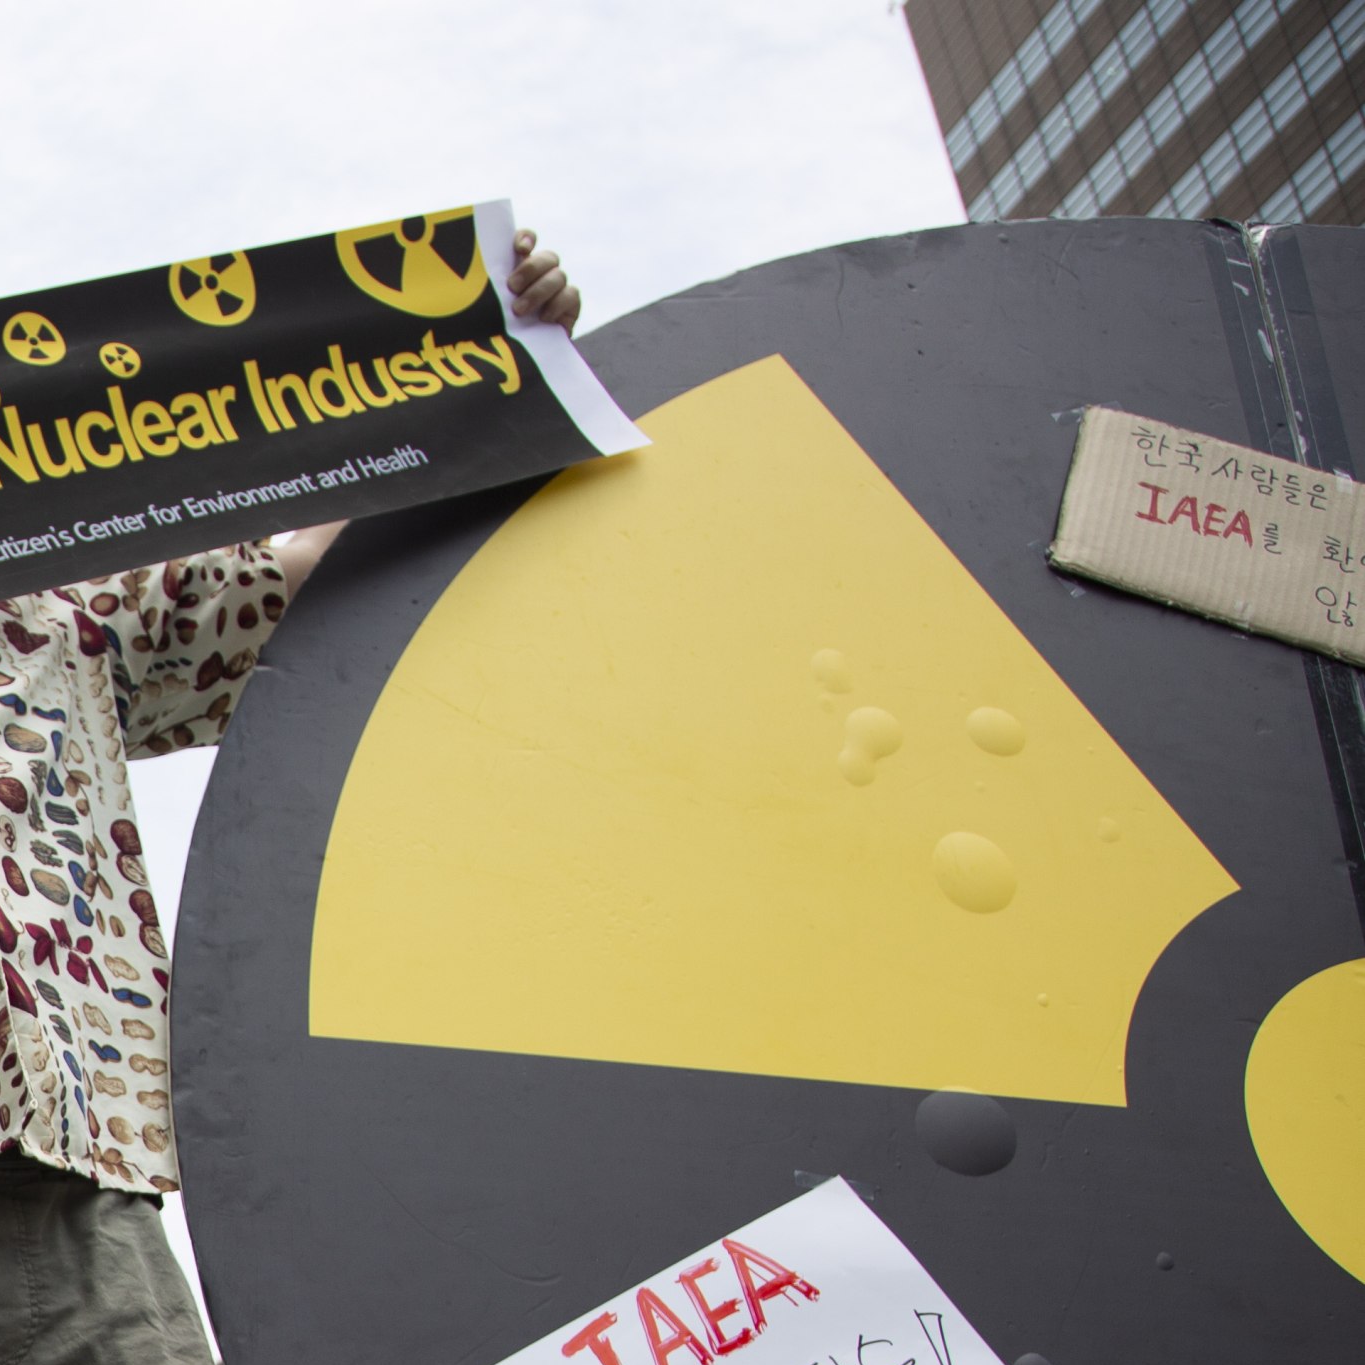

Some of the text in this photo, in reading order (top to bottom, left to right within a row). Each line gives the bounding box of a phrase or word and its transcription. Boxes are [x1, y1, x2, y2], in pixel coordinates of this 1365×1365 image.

[243, 330, 521, 433] Industry
[73, 513, 148, 544] Center
[149, 503, 182, 528] for
[182, 474, 316, 519] Environment
[318, 462, 358, 490] and
[360, 443, 429, 479] Health
[1322, 535, 1365, 573] 환
